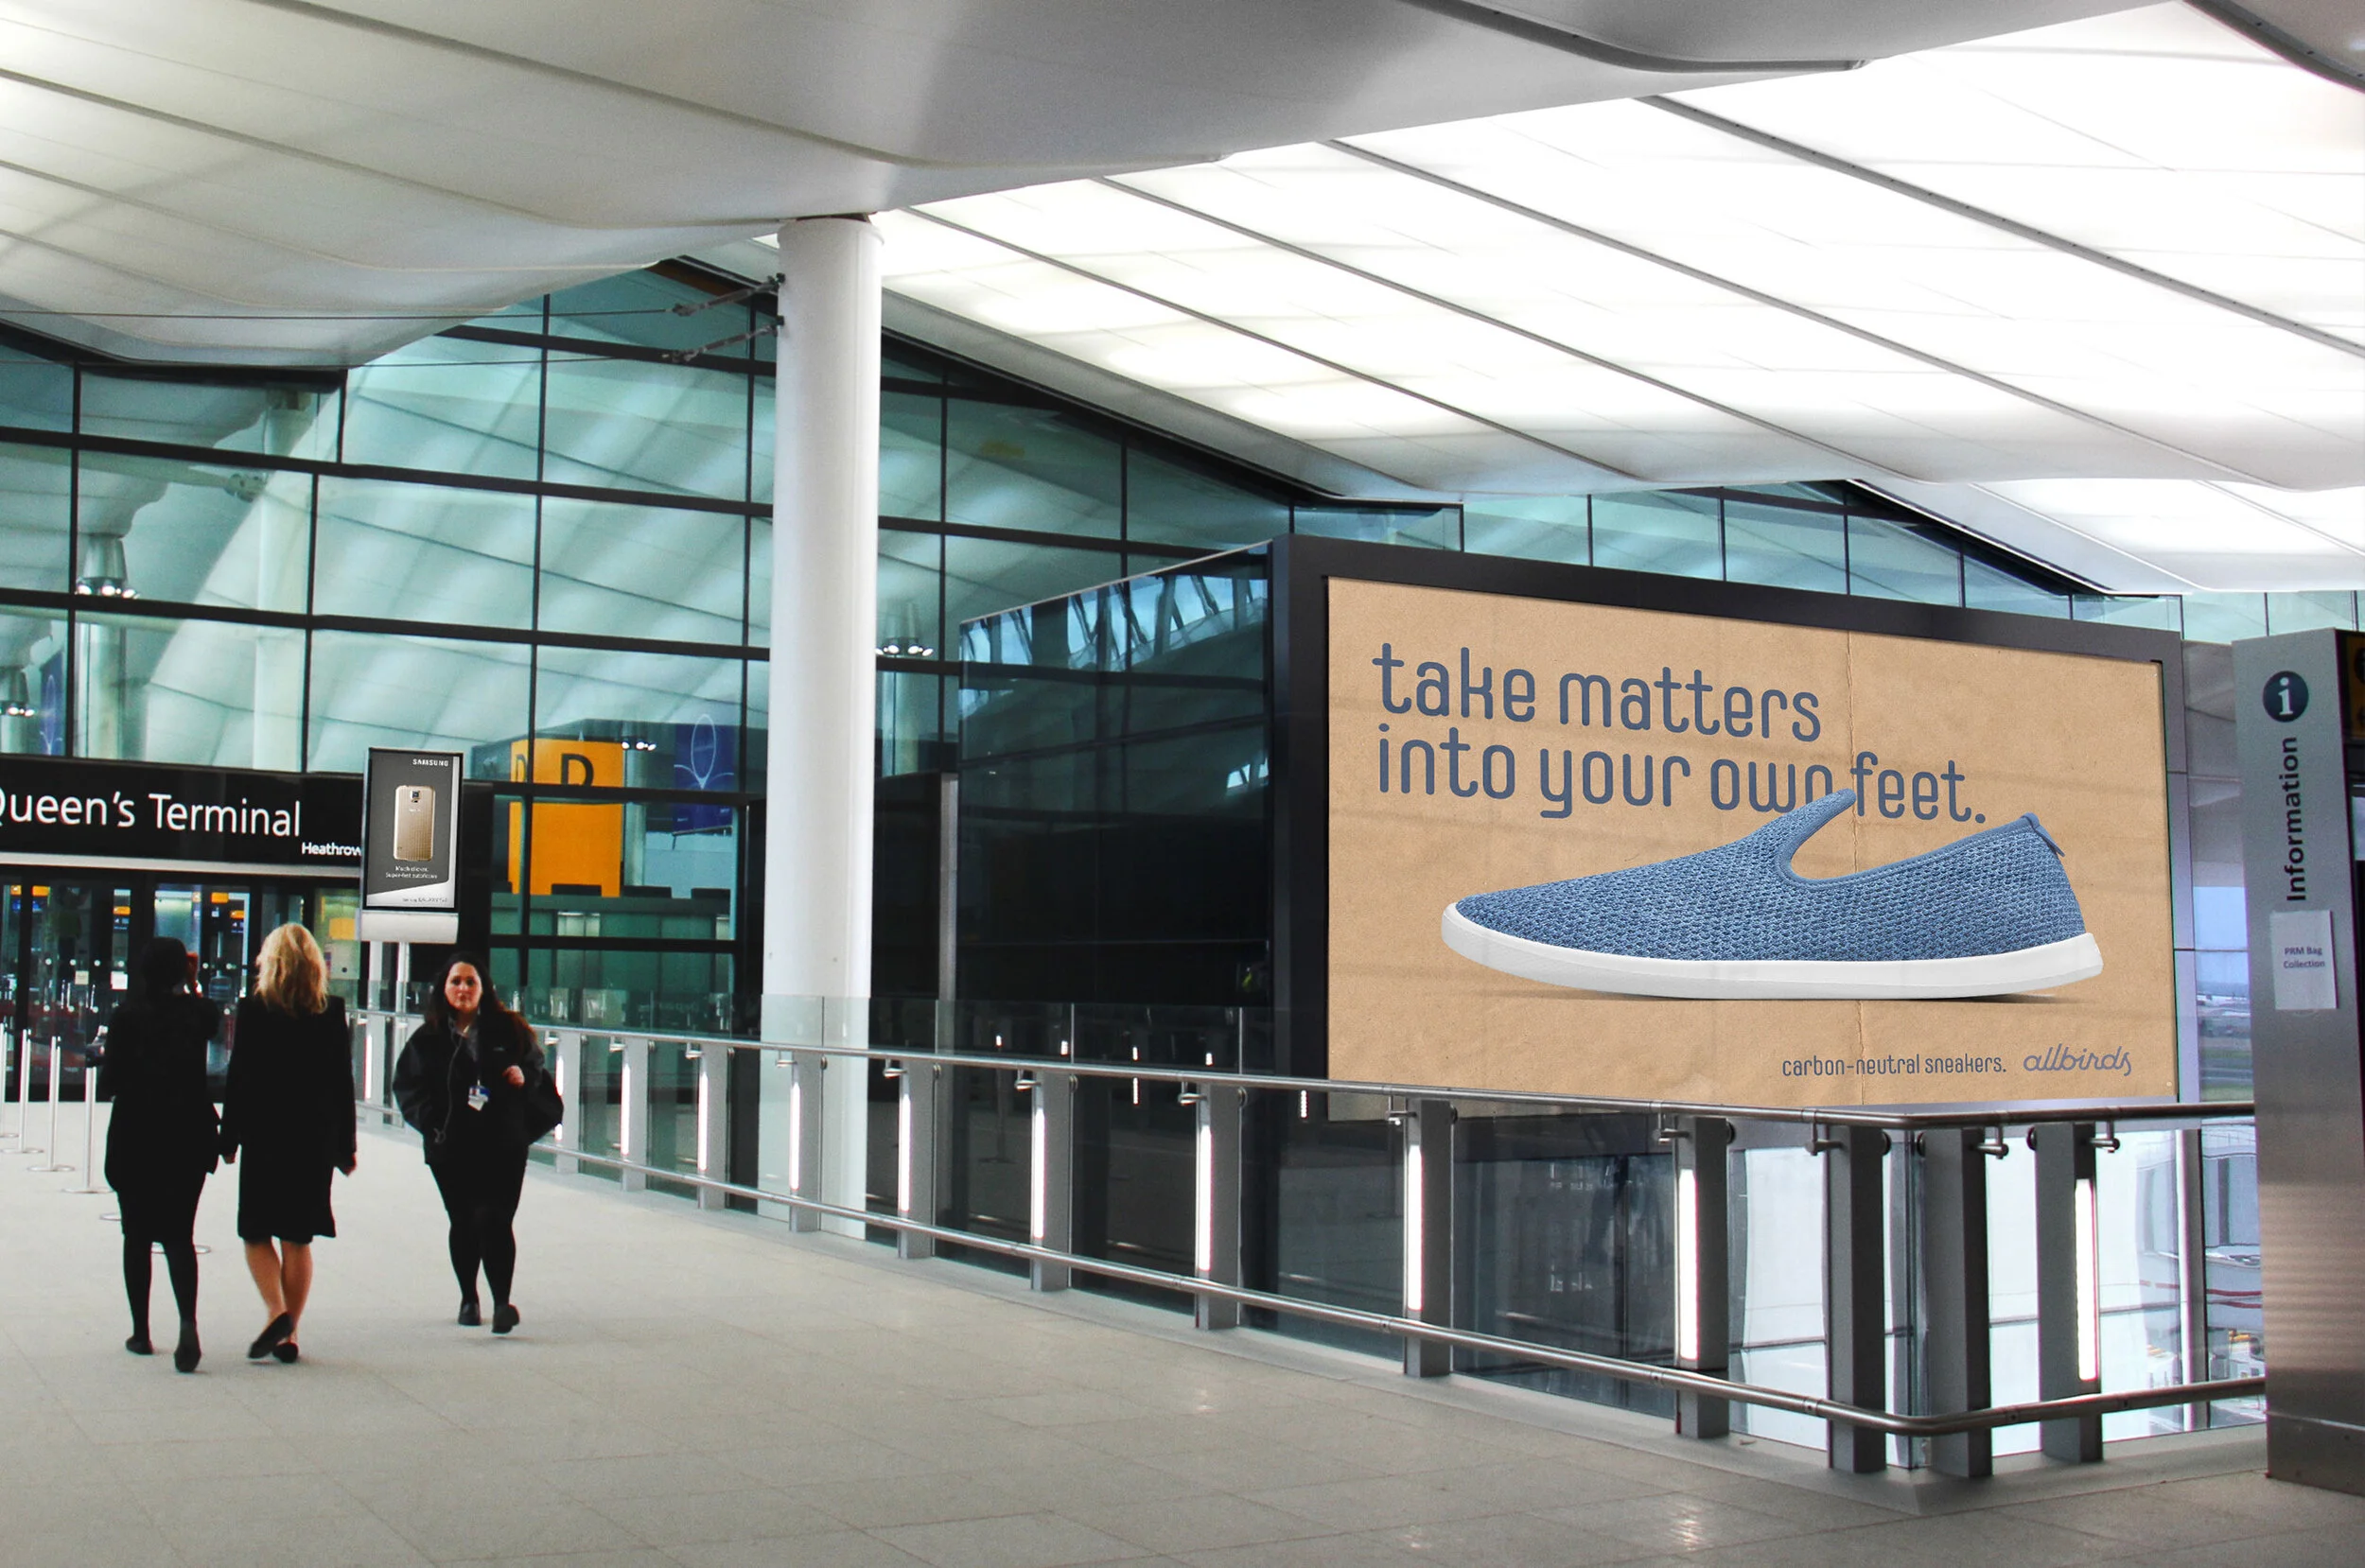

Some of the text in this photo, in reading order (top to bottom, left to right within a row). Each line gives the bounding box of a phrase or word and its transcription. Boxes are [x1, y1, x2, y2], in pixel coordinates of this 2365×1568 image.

[1372, 642, 1822, 742] take matters
[412, 758, 449, 767] SAMSUNG
[560, 753, 595, 786] D
[1377, 723, 1988, 824] into your own feet.
[0, 788, 301, 837] ueen's Terminal
[2278, 737, 2306, 901] Information
[301, 842, 362, 857] Heathrow
[2283, 959, 2326, 969] Collection
[2284, 947, 2323, 957] PRM Bag
[1781, 1042, 2132, 1077] carbon-neutral sneakers. allbirds
